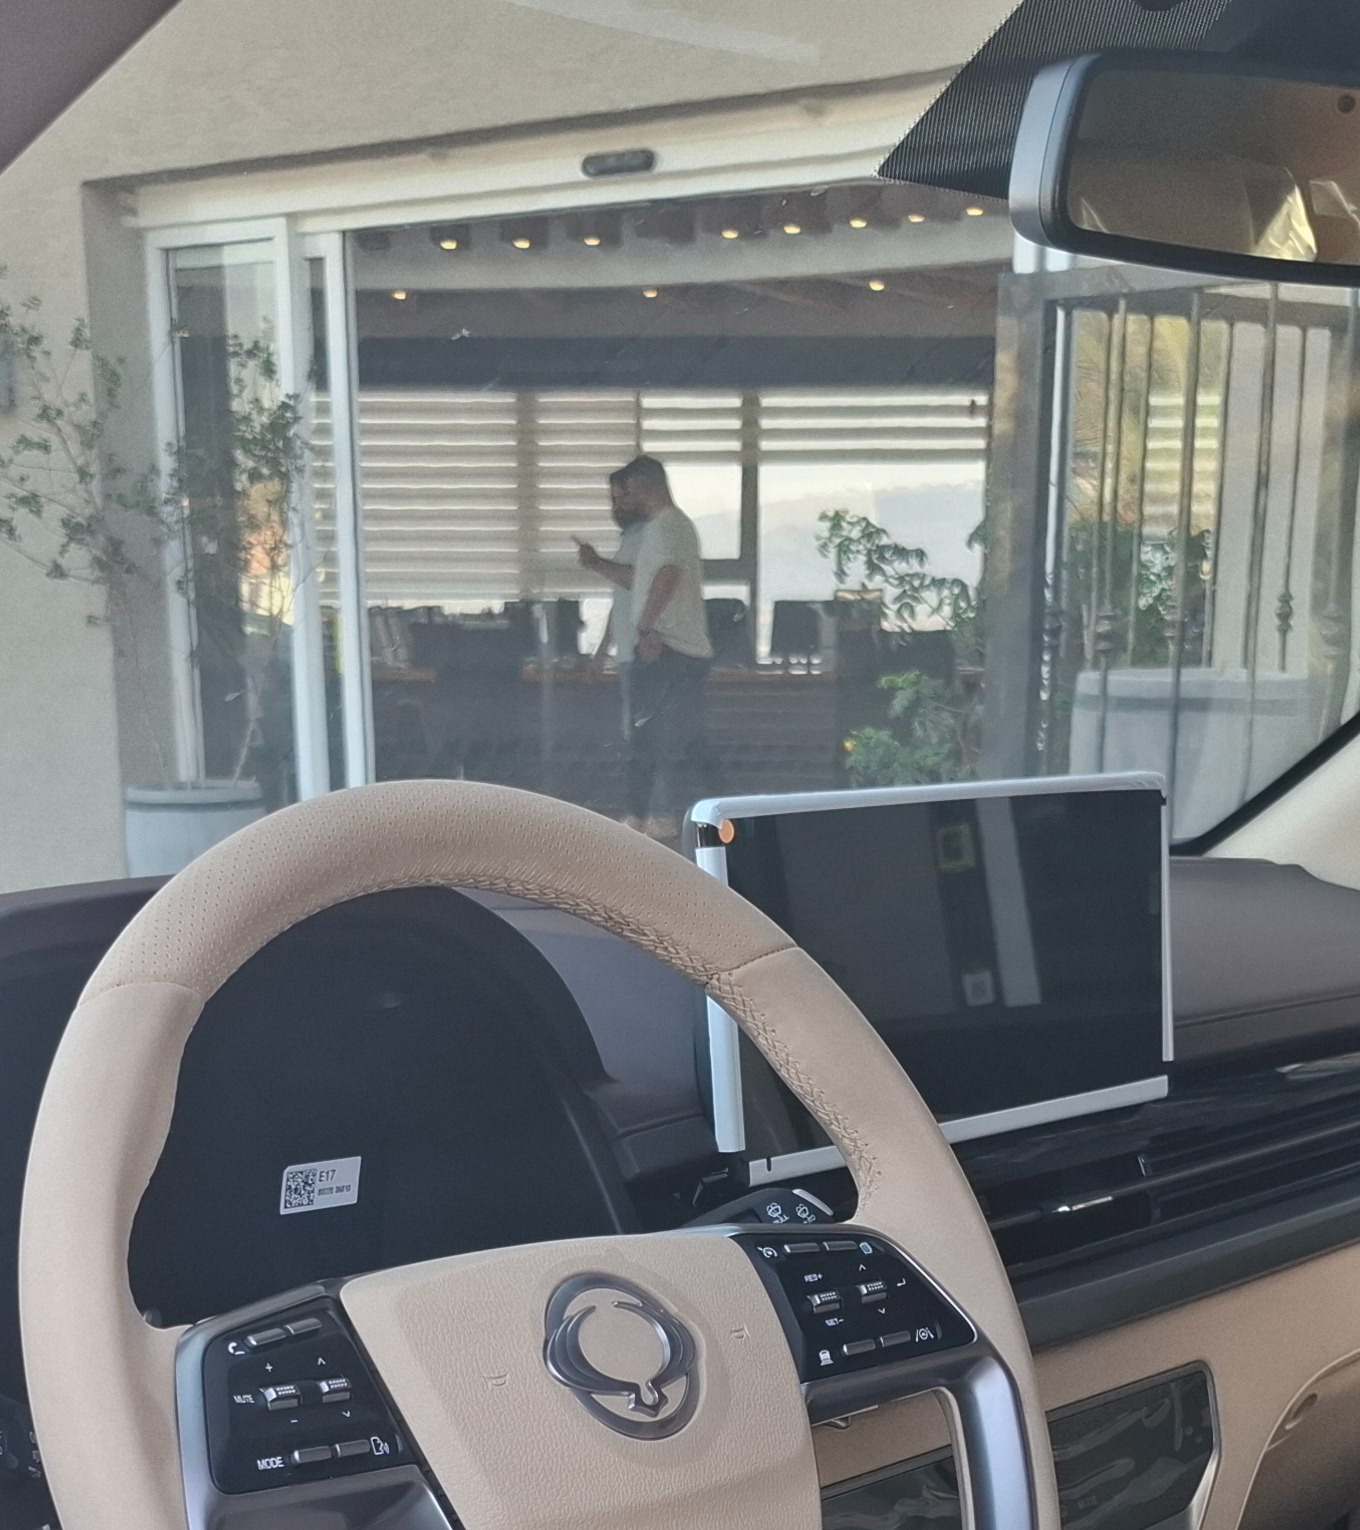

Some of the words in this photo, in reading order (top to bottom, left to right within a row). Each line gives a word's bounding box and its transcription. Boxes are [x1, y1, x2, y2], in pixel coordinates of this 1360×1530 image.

[318, 1169, 337, 1183] E17
[232, 1394, 255, 1404] MUTE
[256, 1456, 286, 1471] MODE
